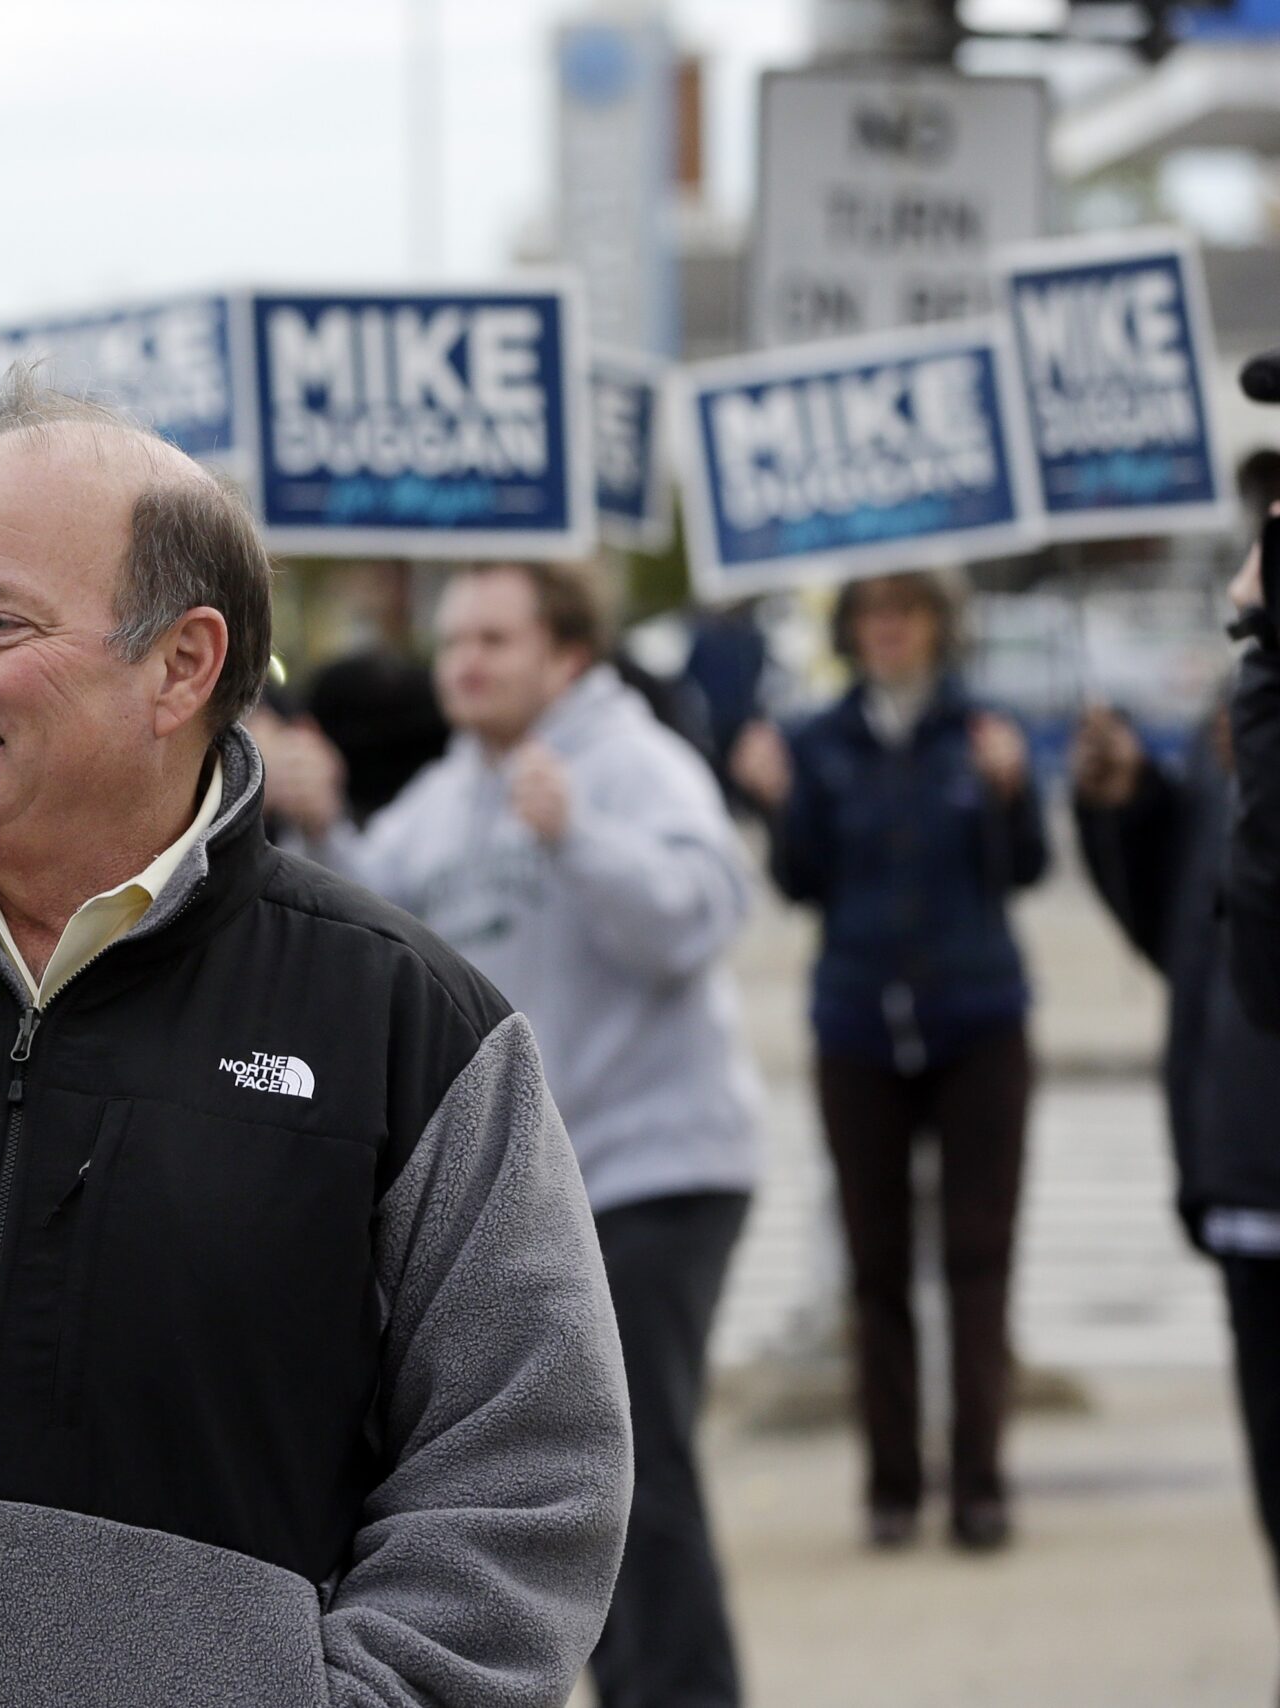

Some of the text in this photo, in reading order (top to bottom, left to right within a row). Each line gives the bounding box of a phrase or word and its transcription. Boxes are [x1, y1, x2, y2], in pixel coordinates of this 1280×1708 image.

[848, 102, 957, 166] NO
[824, 186, 984, 252] TURN
[268, 304, 546, 412] MIKE
[1016, 272, 1188, 396] MIKE
[272, 412, 549, 477] DUGGAN
[714, 355, 992, 472] MIKE
[722, 446, 998, 531] DUGGAN
[218, 1058, 286, 1081] NORTH
[234, 1074, 283, 1093] FACE
[251, 1051, 288, 1069] THE
